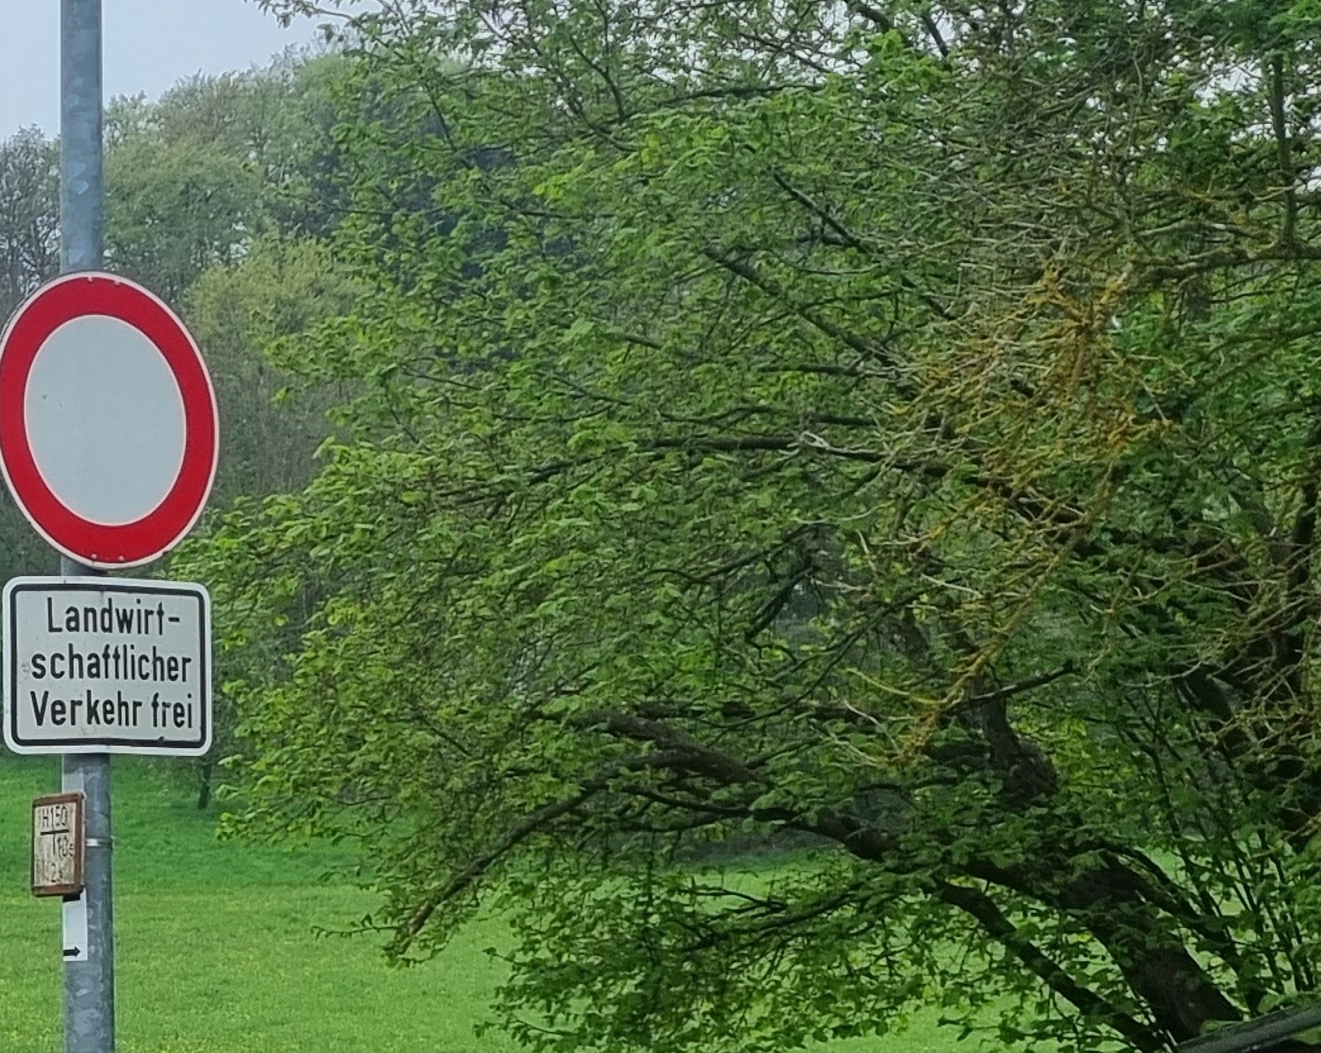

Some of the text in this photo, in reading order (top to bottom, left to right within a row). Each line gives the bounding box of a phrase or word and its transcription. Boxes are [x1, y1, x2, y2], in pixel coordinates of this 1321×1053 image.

[46, 597, 180, 636] Landwirt-
[30, 643, 192, 682] schaftlicher
[30, 689, 193, 728] Verkehr frei
